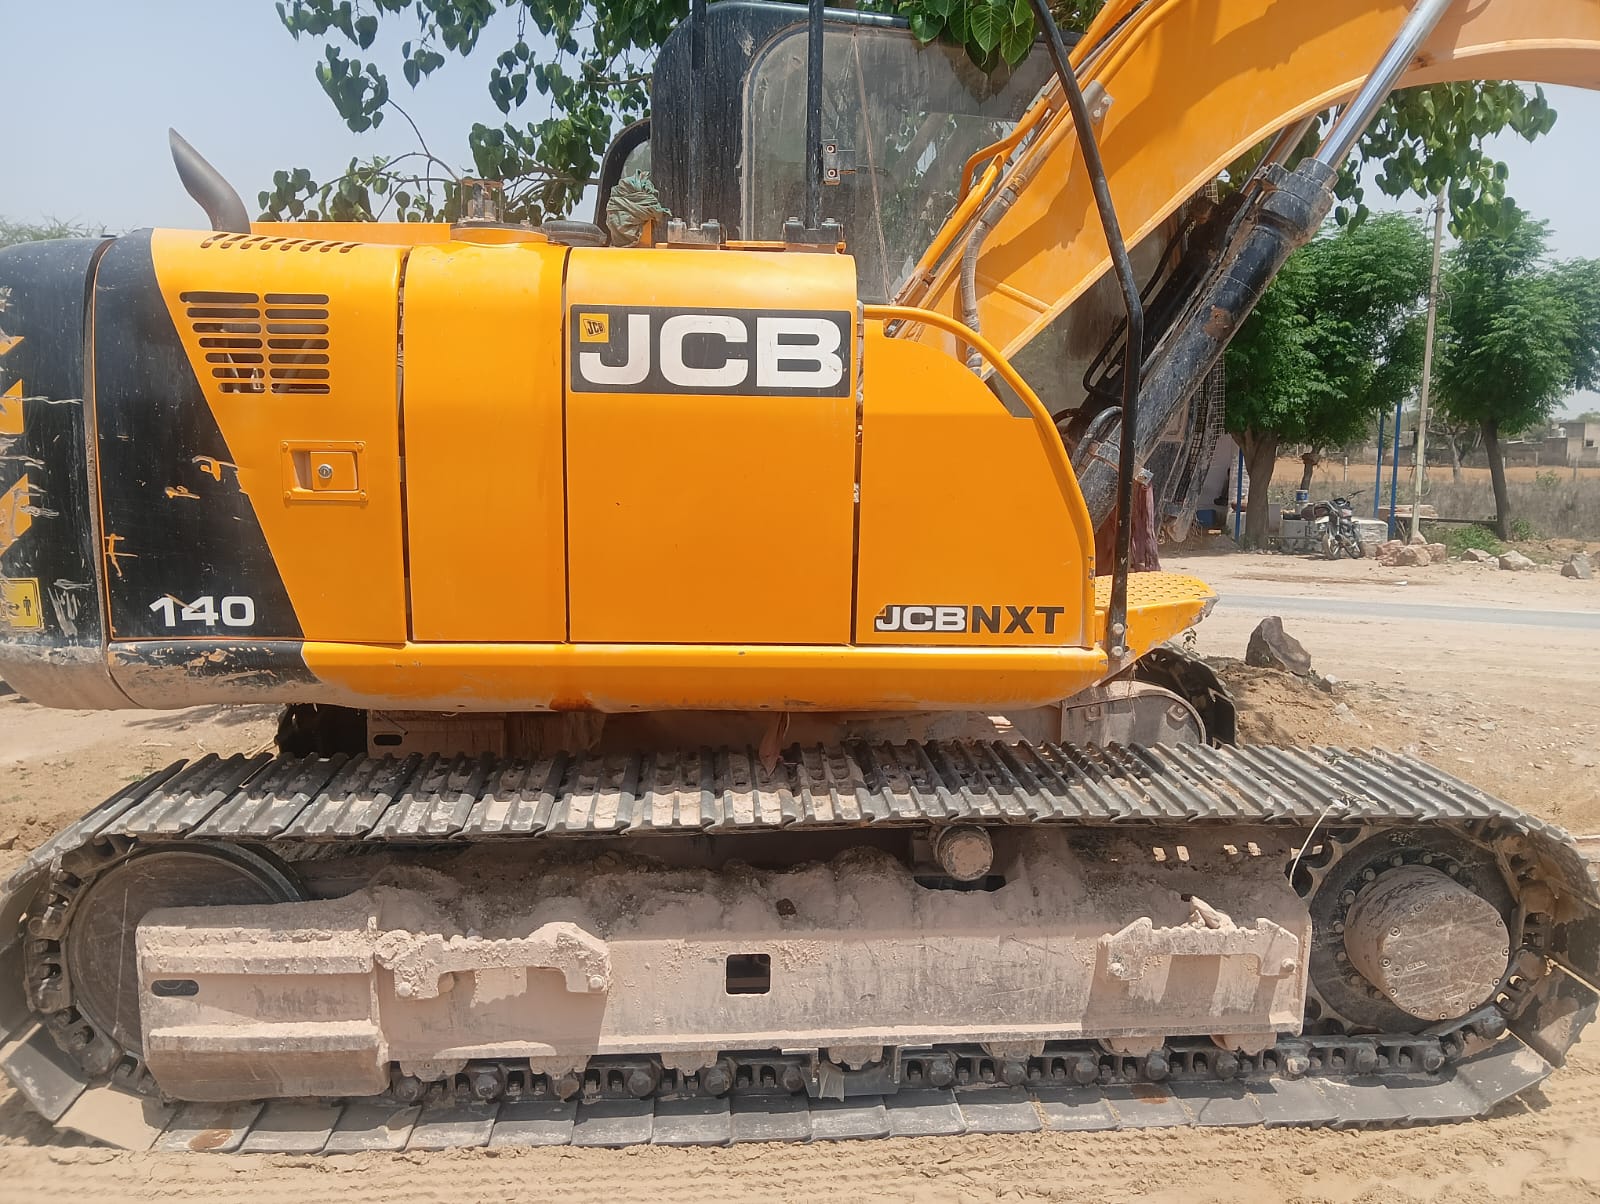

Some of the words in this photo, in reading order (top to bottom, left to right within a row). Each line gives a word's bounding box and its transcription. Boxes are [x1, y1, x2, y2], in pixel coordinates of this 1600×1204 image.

[587, 320, 604, 335] JCB
[579, 313, 843, 388] JCB
[149, 596, 255, 627] 140
